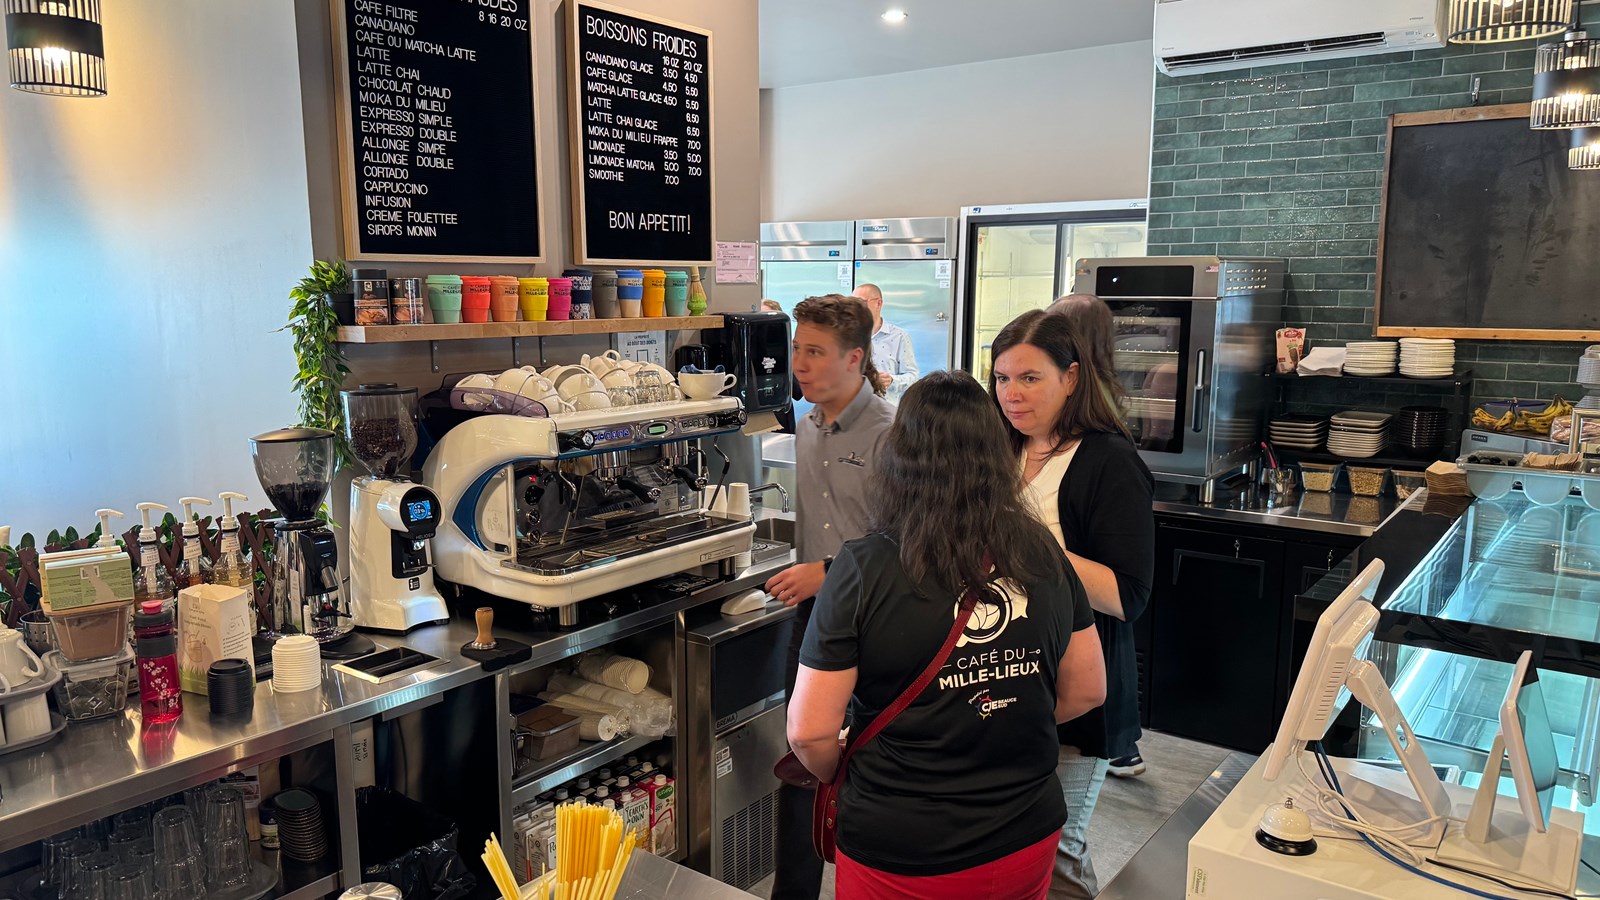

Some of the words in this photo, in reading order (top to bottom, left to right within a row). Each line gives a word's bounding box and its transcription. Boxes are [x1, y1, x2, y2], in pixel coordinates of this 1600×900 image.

[355, 0, 382, 14] CAFE
[386, 6, 418, 22] FILTRE
[478, 10, 484, 22] 8
[488, 13, 497, 24] 16
[500, 16, 511, 27] 20
[514, 18, 528, 30] OZ
[355, 14, 415, 36] CANADIANO
[356, 30, 384, 44] CAFE
[388, 36, 401, 48] OU
[405, 39, 445, 56] MATCHA
[448, 47, 476, 61] LATTE
[586, 15, 647, 46] BOISSONS
[652, 31, 697, 58] FROIDES
[357, 45, 390, 61] LATTE
[358, 60, 391, 77] LATTE
[396, 67, 420, 81] CHAI
[586, 51, 628, 69] CANADIANO
[630, 60, 654, 74] GLACE
[662, 67, 678, 79] 3.50
[684, 73, 698, 84] 4.50
[662, 56, 670, 66] 16
[670, 58, 679, 68] OZ
[683, 60, 692, 70] 20
[693, 63, 703, 73] OZ
[359, 76, 413, 94] CHOCOLAT
[418, 85, 451, 99] CHAUD
[586, 66, 606, 79] CAFE
[608, 70, 633, 84] GLACE
[662, 82, 677, 93] 4.50
[685, 86, 698, 97] 5.50
[360, 91, 392, 106] MOKA
[396, 96, 410, 108] DU
[416, 98, 446, 112] MILIEU
[587, 81, 616, 96] MATCHA
[617, 86, 638, 100] LATTE
[640, 91, 662, 104] GLACE
[663, 96, 677, 106] 4.50
[686, 100, 699, 110] 5.50
[360, 106, 414, 122] EXPRESSO
[419, 113, 452, 128] SIMPLE
[588, 96, 611, 109] LATTE
[686, 113, 699, 124] 6.50
[362, 121, 414, 137] EXPRESSO
[420, 128, 457, 142] DOUBLE
[589, 110, 612, 124] LATTE
[616, 115, 633, 127] CHAI
[635, 118, 658, 131] GLACE
[687, 126, 700, 137] 6.50
[362, 136, 410, 151] ALLONGE
[418, 142, 446, 155] SIMPE
[588, 125, 610, 137] MOKA
[612, 128, 623, 139] DU
[626, 130, 651, 144] MILIEU
[653, 134, 678, 147] FRAPPE
[363, 151, 408, 166] ALLONGE
[417, 156, 454, 170] DOUBLE
[589, 140, 625, 154] LIMONADE
[664, 150, 678, 160] 3.50
[687, 153, 701, 163] 5.00
[364, 166, 408, 179] CORTADO
[589, 154, 624, 168] LIMONADE
[626, 159, 655, 171] MATCHA
[664, 162, 679, 172] 5.00
[589, 169, 624, 182] SMOOTHIE
[364, 180, 428, 195] CAPPUCCINO
[366, 195, 411, 208] INFUSION
[366, 210, 402, 222] CREME
[408, 212, 458, 224] FOUETTEE
[609, 210, 634, 229] BON
[638, 212, 690, 235] APPETIT!
[368, 224, 402, 236] SIROPS
[407, 225, 436, 237] MONIN
[957, 648, 998, 670] CAFÉ
[1004, 648, 1025, 661] DU
[938, 660, 1040, 690] MILLE-LIEUX
